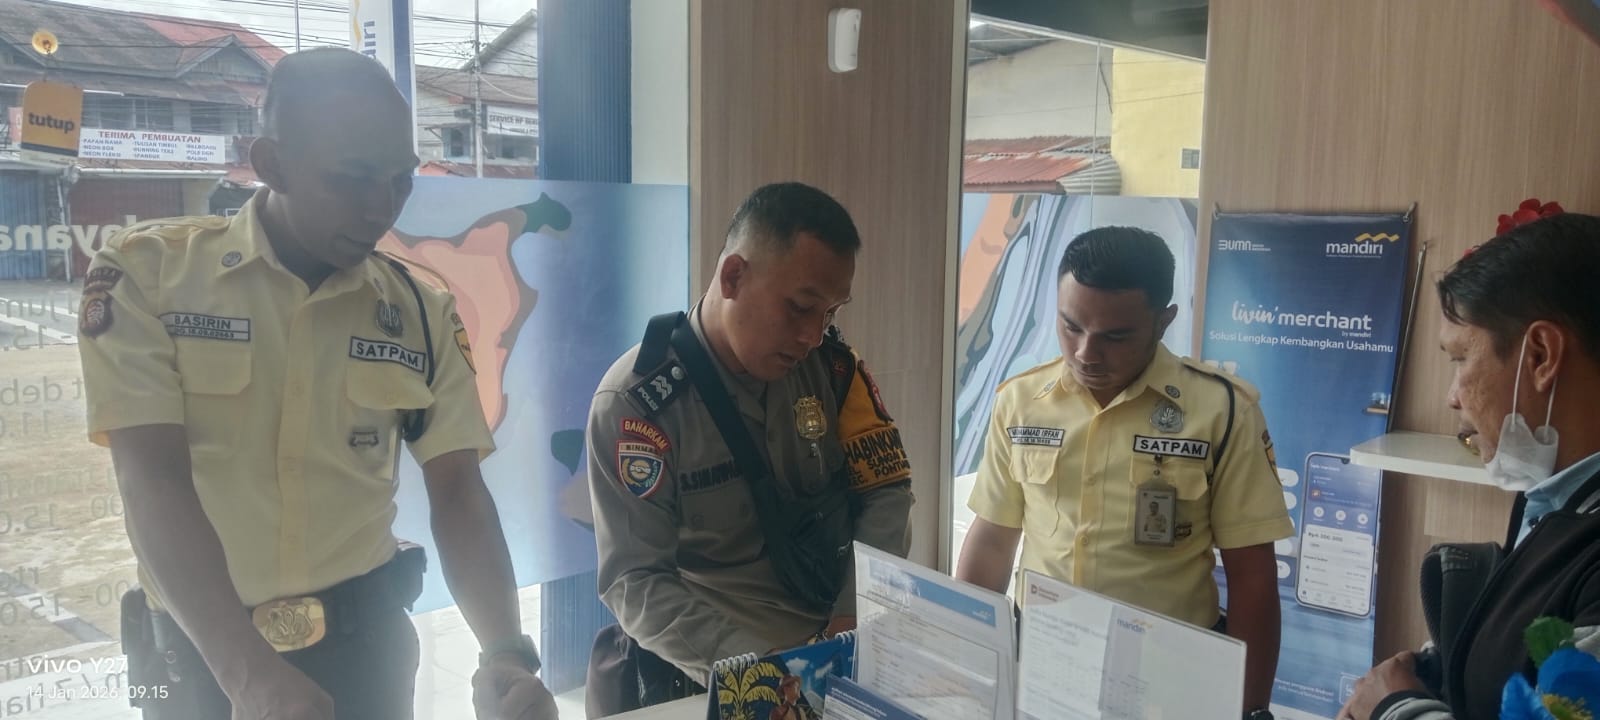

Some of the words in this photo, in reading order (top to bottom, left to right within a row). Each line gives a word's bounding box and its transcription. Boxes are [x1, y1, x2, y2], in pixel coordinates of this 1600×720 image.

[28, 112, 75, 134] tutup
[99, 131, 136, 140] TERIMA
[142, 133, 201, 143] PEMBUATAN
[1326, 240, 1383, 255] mandiri
[175, 315, 231, 329] BASIRIN
[1278, 311, 1373, 331] merchant
[1209, 329, 1236, 341] Solusi
[1238, 332, 1279, 346] Lengkap
[1280, 335, 1344, 350] Kembangkan
[1346, 340, 1394, 353] Usahamu
[356, 342, 419, 367] SATPAM
[624, 420, 668, 450] BAHARKAM
[1140, 439, 1203, 455] SATPAM
